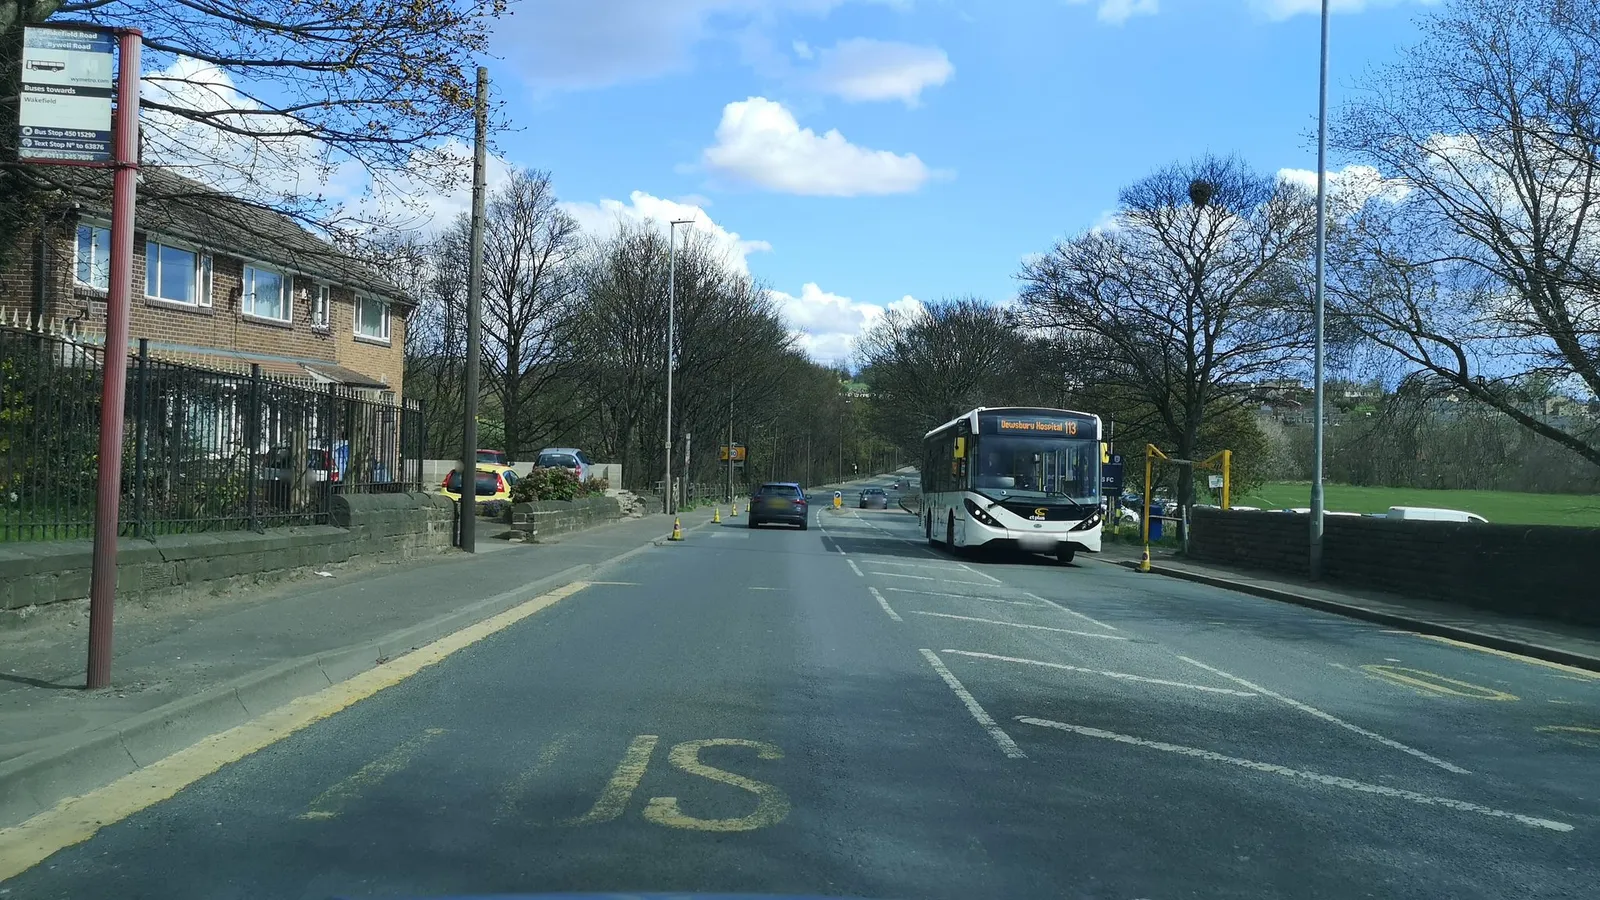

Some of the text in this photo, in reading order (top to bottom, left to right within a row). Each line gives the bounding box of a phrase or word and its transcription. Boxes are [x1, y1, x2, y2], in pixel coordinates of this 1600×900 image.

[1001, 420, 1076, 435] Dewsbury Hospital 113
